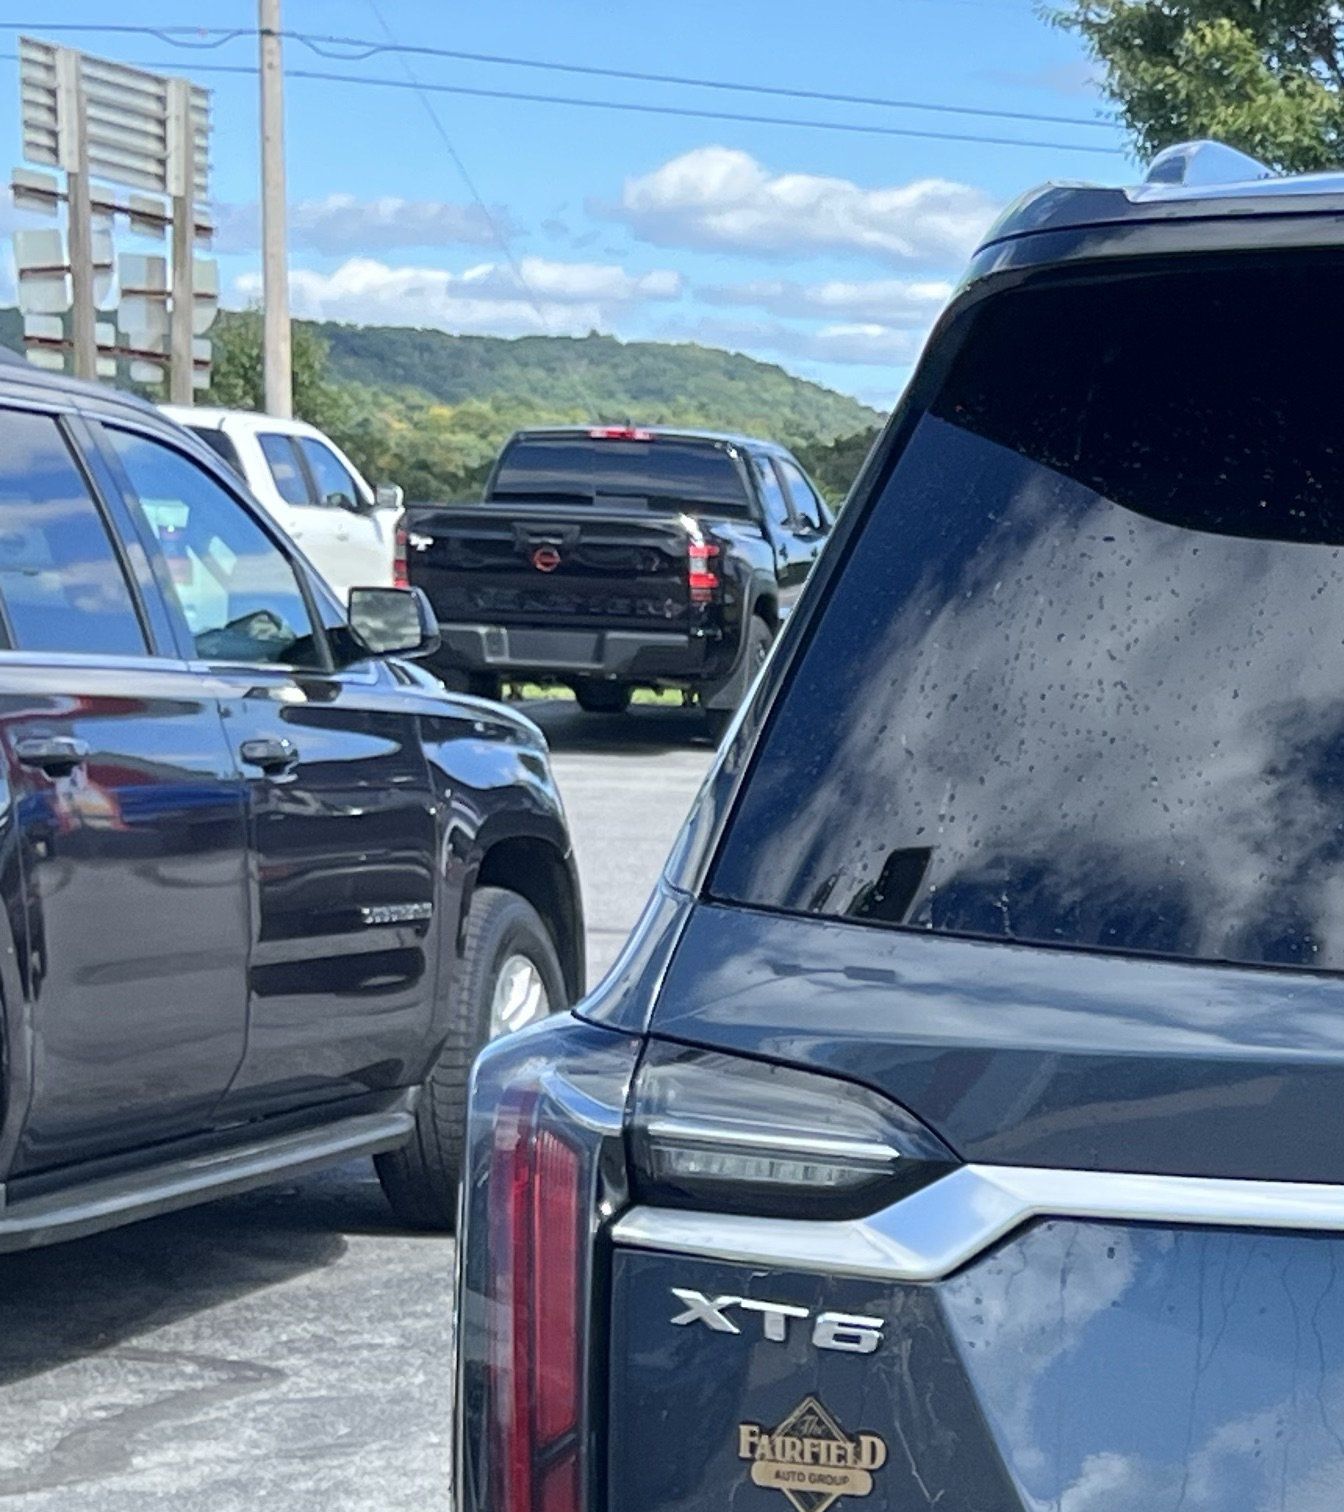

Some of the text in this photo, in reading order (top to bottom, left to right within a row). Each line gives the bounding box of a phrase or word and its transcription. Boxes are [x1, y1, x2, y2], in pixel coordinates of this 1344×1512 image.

[670, 1287, 885, 1353] XT6
[738, 1424, 886, 1470] FAIRFIELD
[774, 1470, 850, 1486] AUTO GROUP
